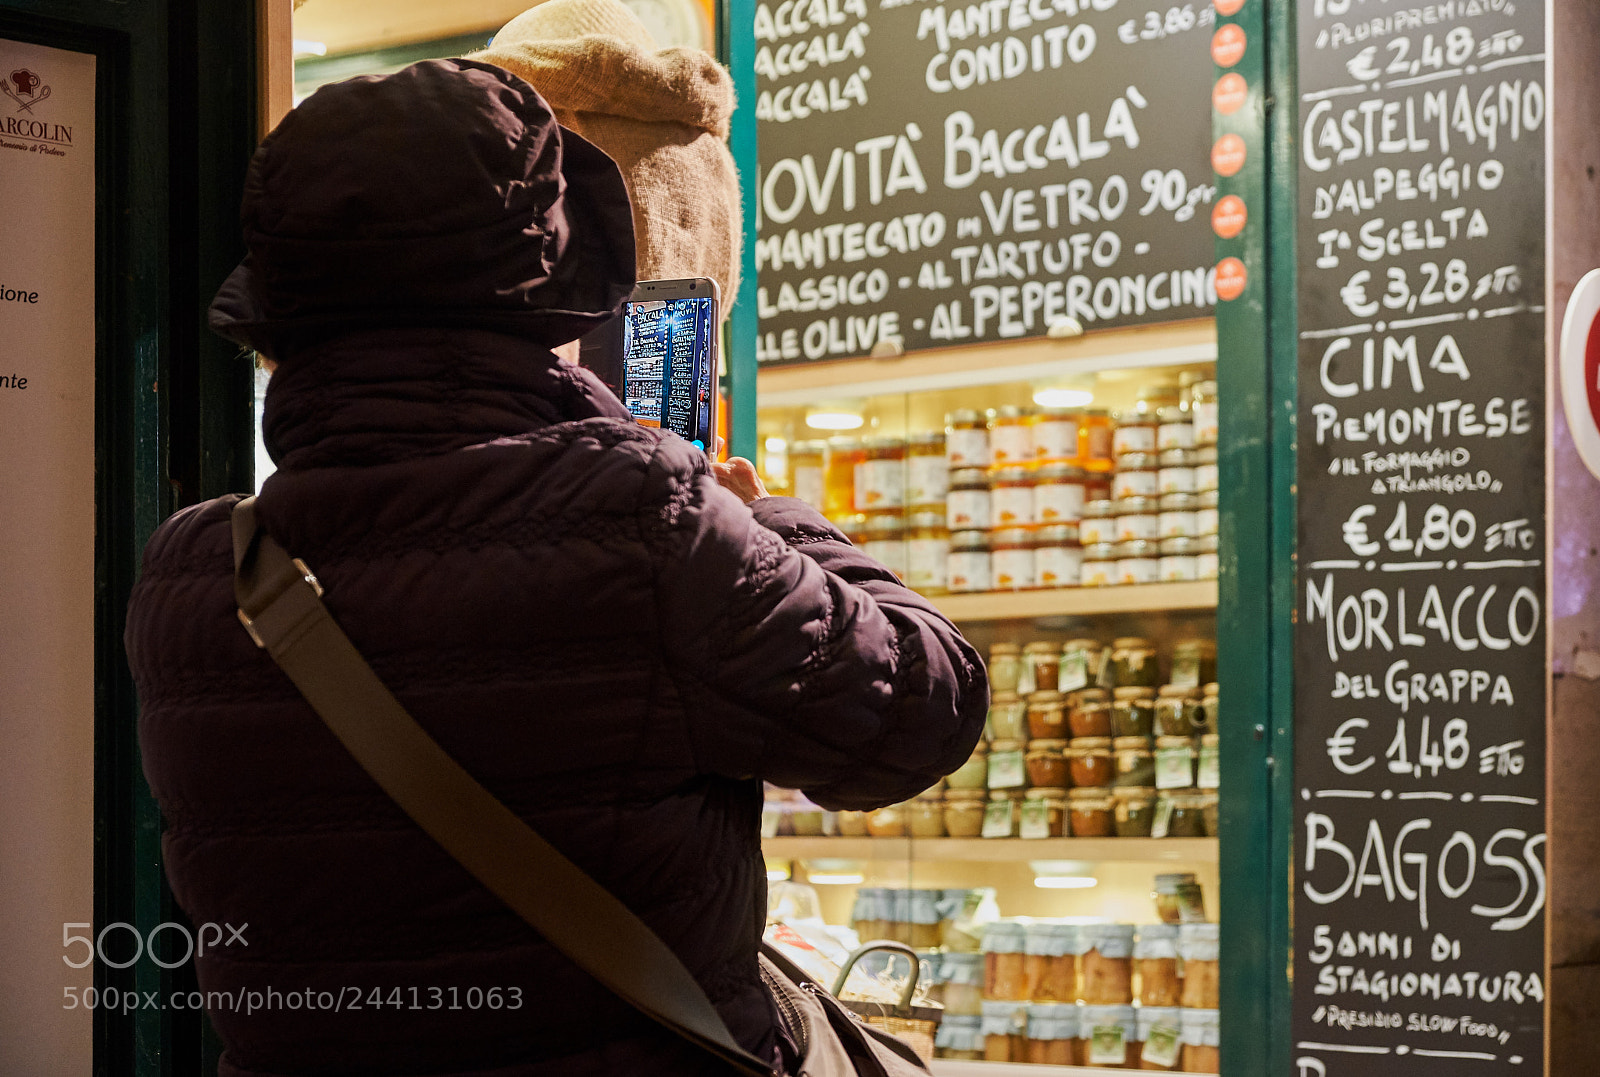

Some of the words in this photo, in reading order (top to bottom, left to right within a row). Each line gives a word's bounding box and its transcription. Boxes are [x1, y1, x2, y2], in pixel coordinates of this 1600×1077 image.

[925, 24, 1098, 93] CONDITO
[1346, 45, 1382, 81] €
[1384, 26, 1475, 76] 2,48
[1302, 79, 1546, 172] CASTELMAGNO
[755, 122, 927, 231] OVITÀ
[1311, 158, 1505, 220] D'ALPEGGIO
[755, 211, 946, 272] MANTECATO
[980, 174, 1130, 236] VETRO
[1356, 206, 1489, 261] SCELTA
[916, 261, 953, 291] AL
[950, 230, 1122, 285] TARTUFO
[1339, 269, 1380, 317] €
[1382, 258, 1470, 314] 3,28
[801, 311, 904, 360] OLIVE
[928, 299, 973, 340] AL
[1319, 334, 1471, 398] CIMA
[1311, 397, 1532, 446] PIEMONTESE
[1361, 446, 1471, 481] FORMAGGIO
[1341, 503, 1381, 557] €
[1383, 500, 1477, 558] 1,80
[1305, 572, 1541, 662] MORLACCO
[1331, 671, 1381, 699] DEL
[1384, 659, 1515, 713] GRAPPA
[1325, 716, 1377, 775] €
[1385, 714, 1470, 779] 1,48
[1302, 811, 1549, 932] BAGOSS
[1430, 932, 1462, 962] DI
[1313, 964, 1545, 1004] STAGIONATURA
[1405, 1011, 1459, 1034] SLOW
